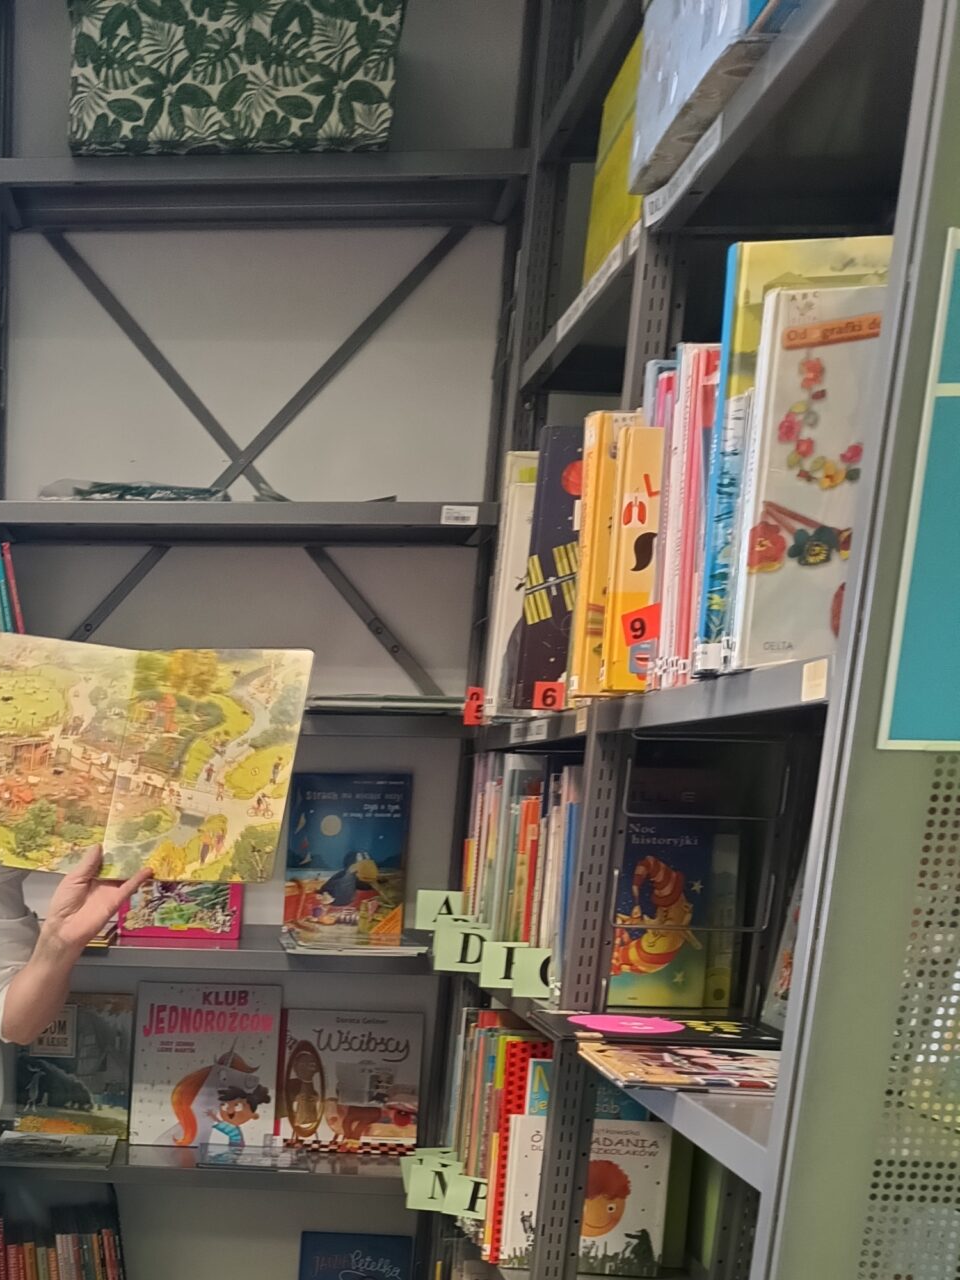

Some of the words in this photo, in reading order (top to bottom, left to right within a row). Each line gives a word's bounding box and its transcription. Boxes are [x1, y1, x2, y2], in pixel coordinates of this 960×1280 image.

[630, 618, 647, 640] 9
[762, 641, 794, 651] DELTA
[542, 687, 558, 707] 6
[631, 834, 699, 847] historyjki
[432, 895, 454, 923] A
[456, 932, 487, 965] D
[201, 989, 249, 1006] KLUB
[143, 1003, 274, 1037] JEDNOROŻCÓW
